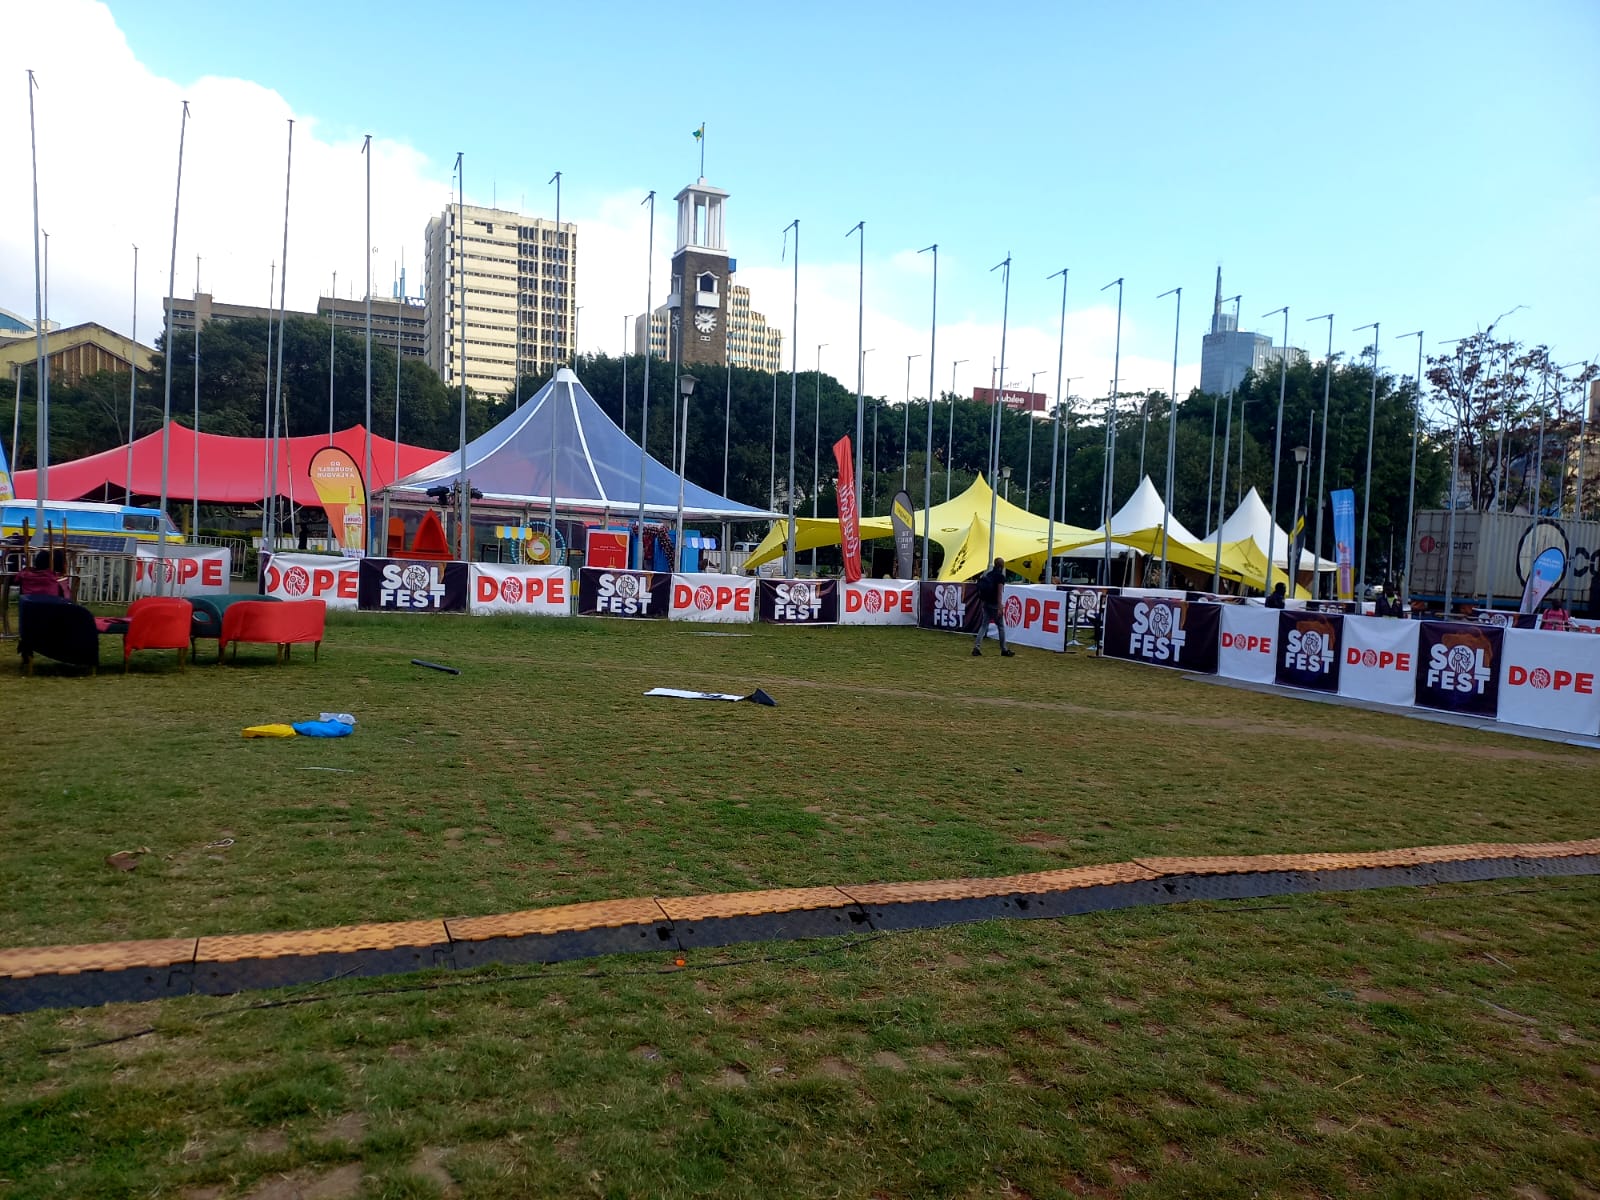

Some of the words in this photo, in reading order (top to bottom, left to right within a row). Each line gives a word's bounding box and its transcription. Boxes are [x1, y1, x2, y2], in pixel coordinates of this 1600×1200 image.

[381, 564, 446, 592] SOL
[477, 575, 565, 605] DOPE
[597, 573, 652, 598] SOL
[380, 590, 446, 608] FEST
[596, 597, 652, 615] FEST
[673, 584, 750, 612] DOPE
[774, 583, 822, 605] SOL
[845, 588, 913, 614] DOPE
[934, 584, 966, 611] SOL
[774, 605, 822, 620] FEST
[933, 608, 966, 628] FEST
[1004, 595, 1061, 634] OPE
[1132, 602, 1186, 639] SOL
[1129, 633, 1186, 662] FEST
[1221, 632, 1272, 654] DOPE
[1286, 629, 1335, 657] SOL
[1285, 652, 1335, 674] FEST
[1346, 647, 1411, 671] DOPE
[1429, 643, 1491, 675] SOL
[1426, 670, 1491, 694] FEST
[1508, 665, 1594, 694] DOPE
